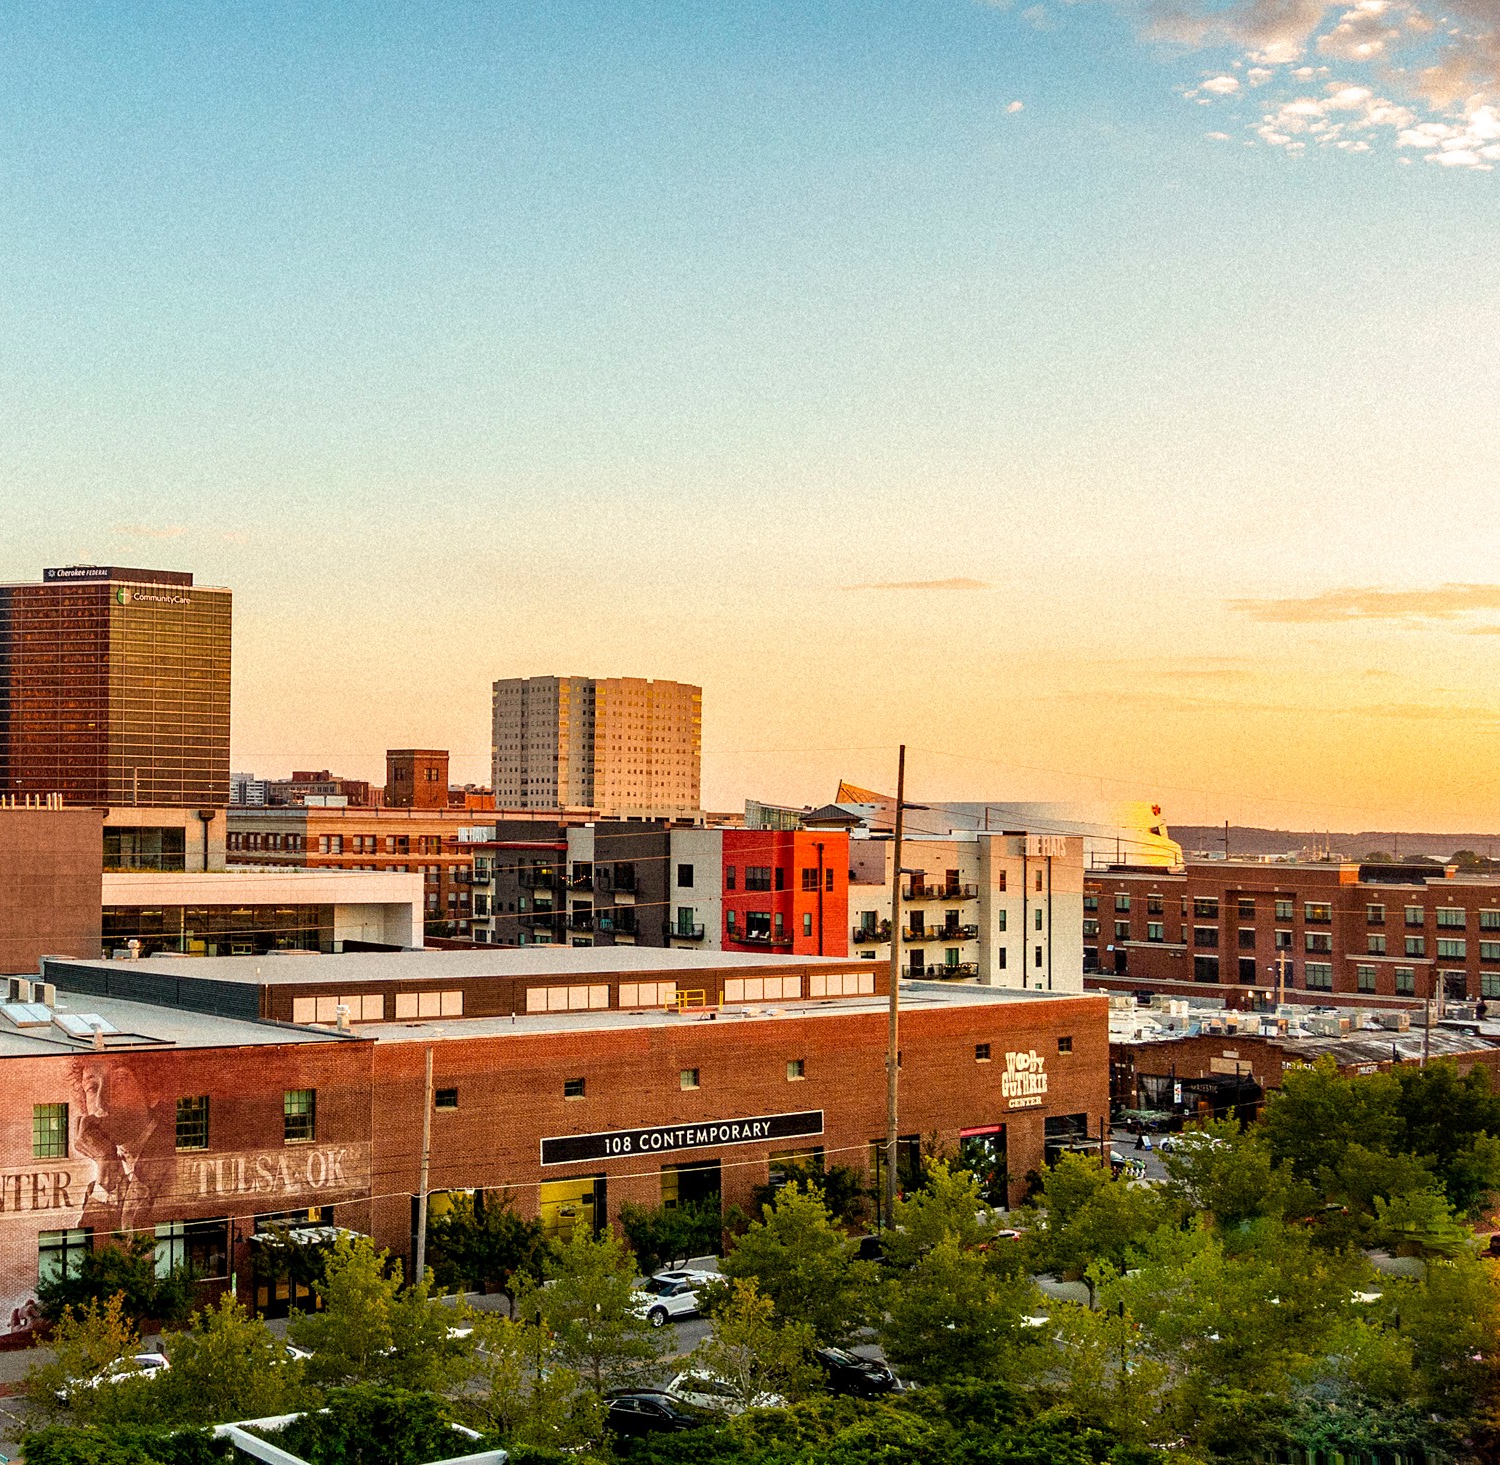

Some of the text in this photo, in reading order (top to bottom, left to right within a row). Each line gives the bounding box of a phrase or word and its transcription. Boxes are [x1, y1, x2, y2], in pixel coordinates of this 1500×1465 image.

[56, 569, 85, 577] Cherokee
[133, 592, 191, 604] CommunityCare
[1005, 1050, 1044, 1081] WOODY
[1001, 1071, 1047, 1097] GUTHRIE
[1009, 1096, 1042, 1108] CENTER
[604, 1121, 771, 1153] 108 CONTEMPORARY
[307, 1150, 348, 1188] OK
